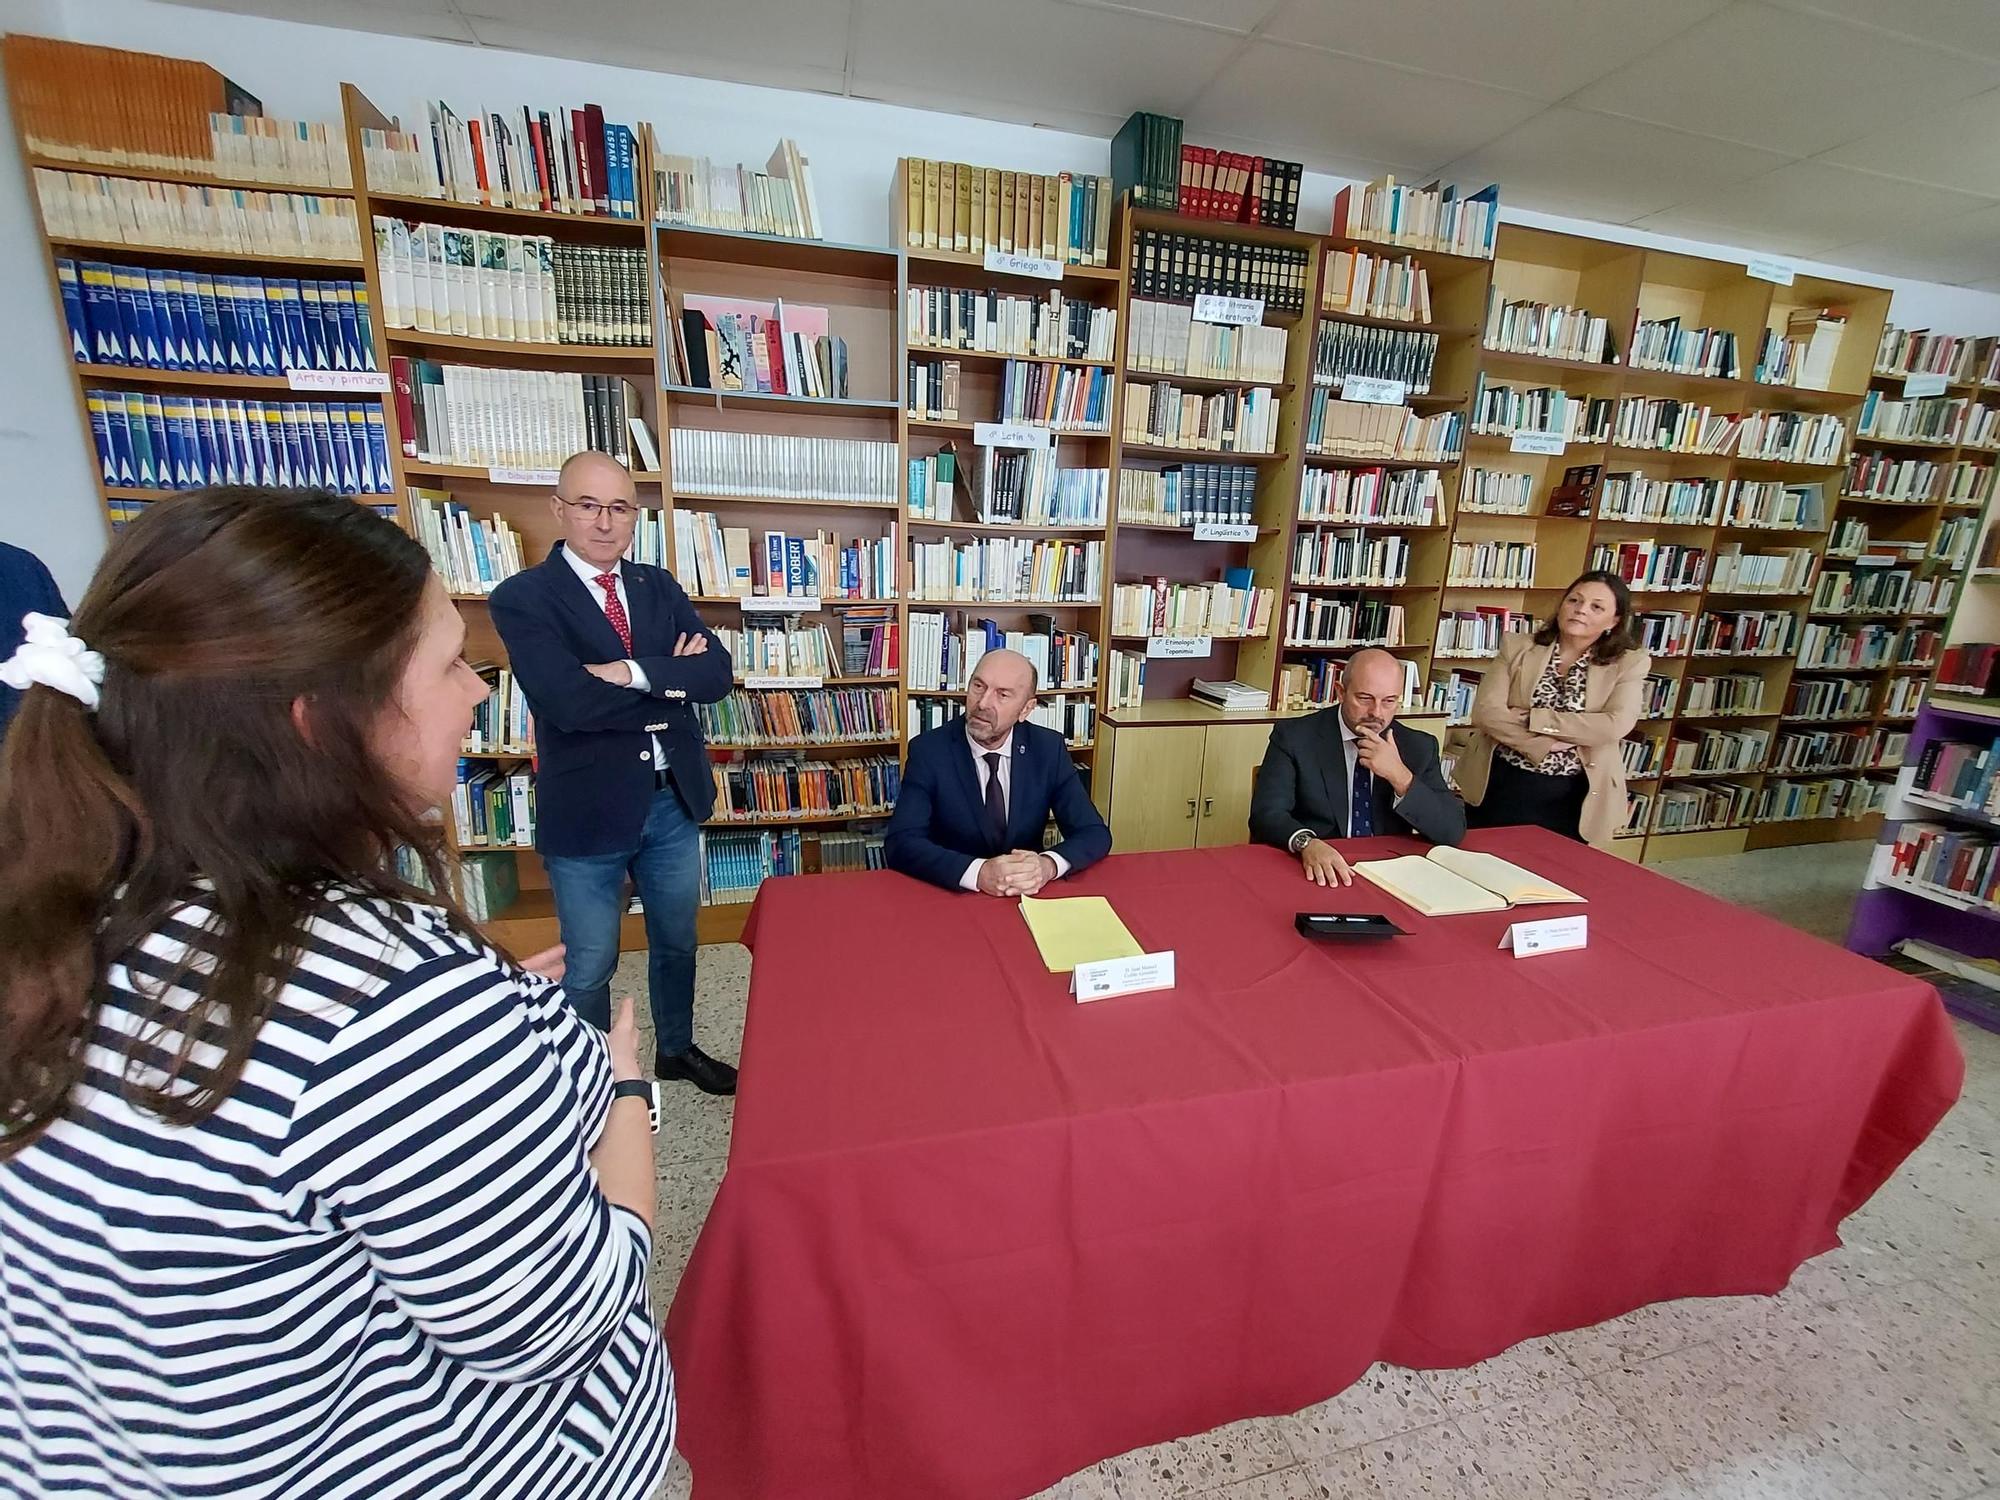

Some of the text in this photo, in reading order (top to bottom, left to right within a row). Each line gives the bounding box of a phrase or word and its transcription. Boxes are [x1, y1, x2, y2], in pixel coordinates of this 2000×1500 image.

[606, 130, 617, 168] ESPAÑA
[619, 132, 630, 169] ESPAÑA
[1009, 257, 1039, 273] Griego
[296, 374, 384, 386] Arte y pintura
[1002, 432, 1024, 441] Latín
[790, 541, 803, 584] ROBERT
[1165, 639, 1195, 647] Etimología
